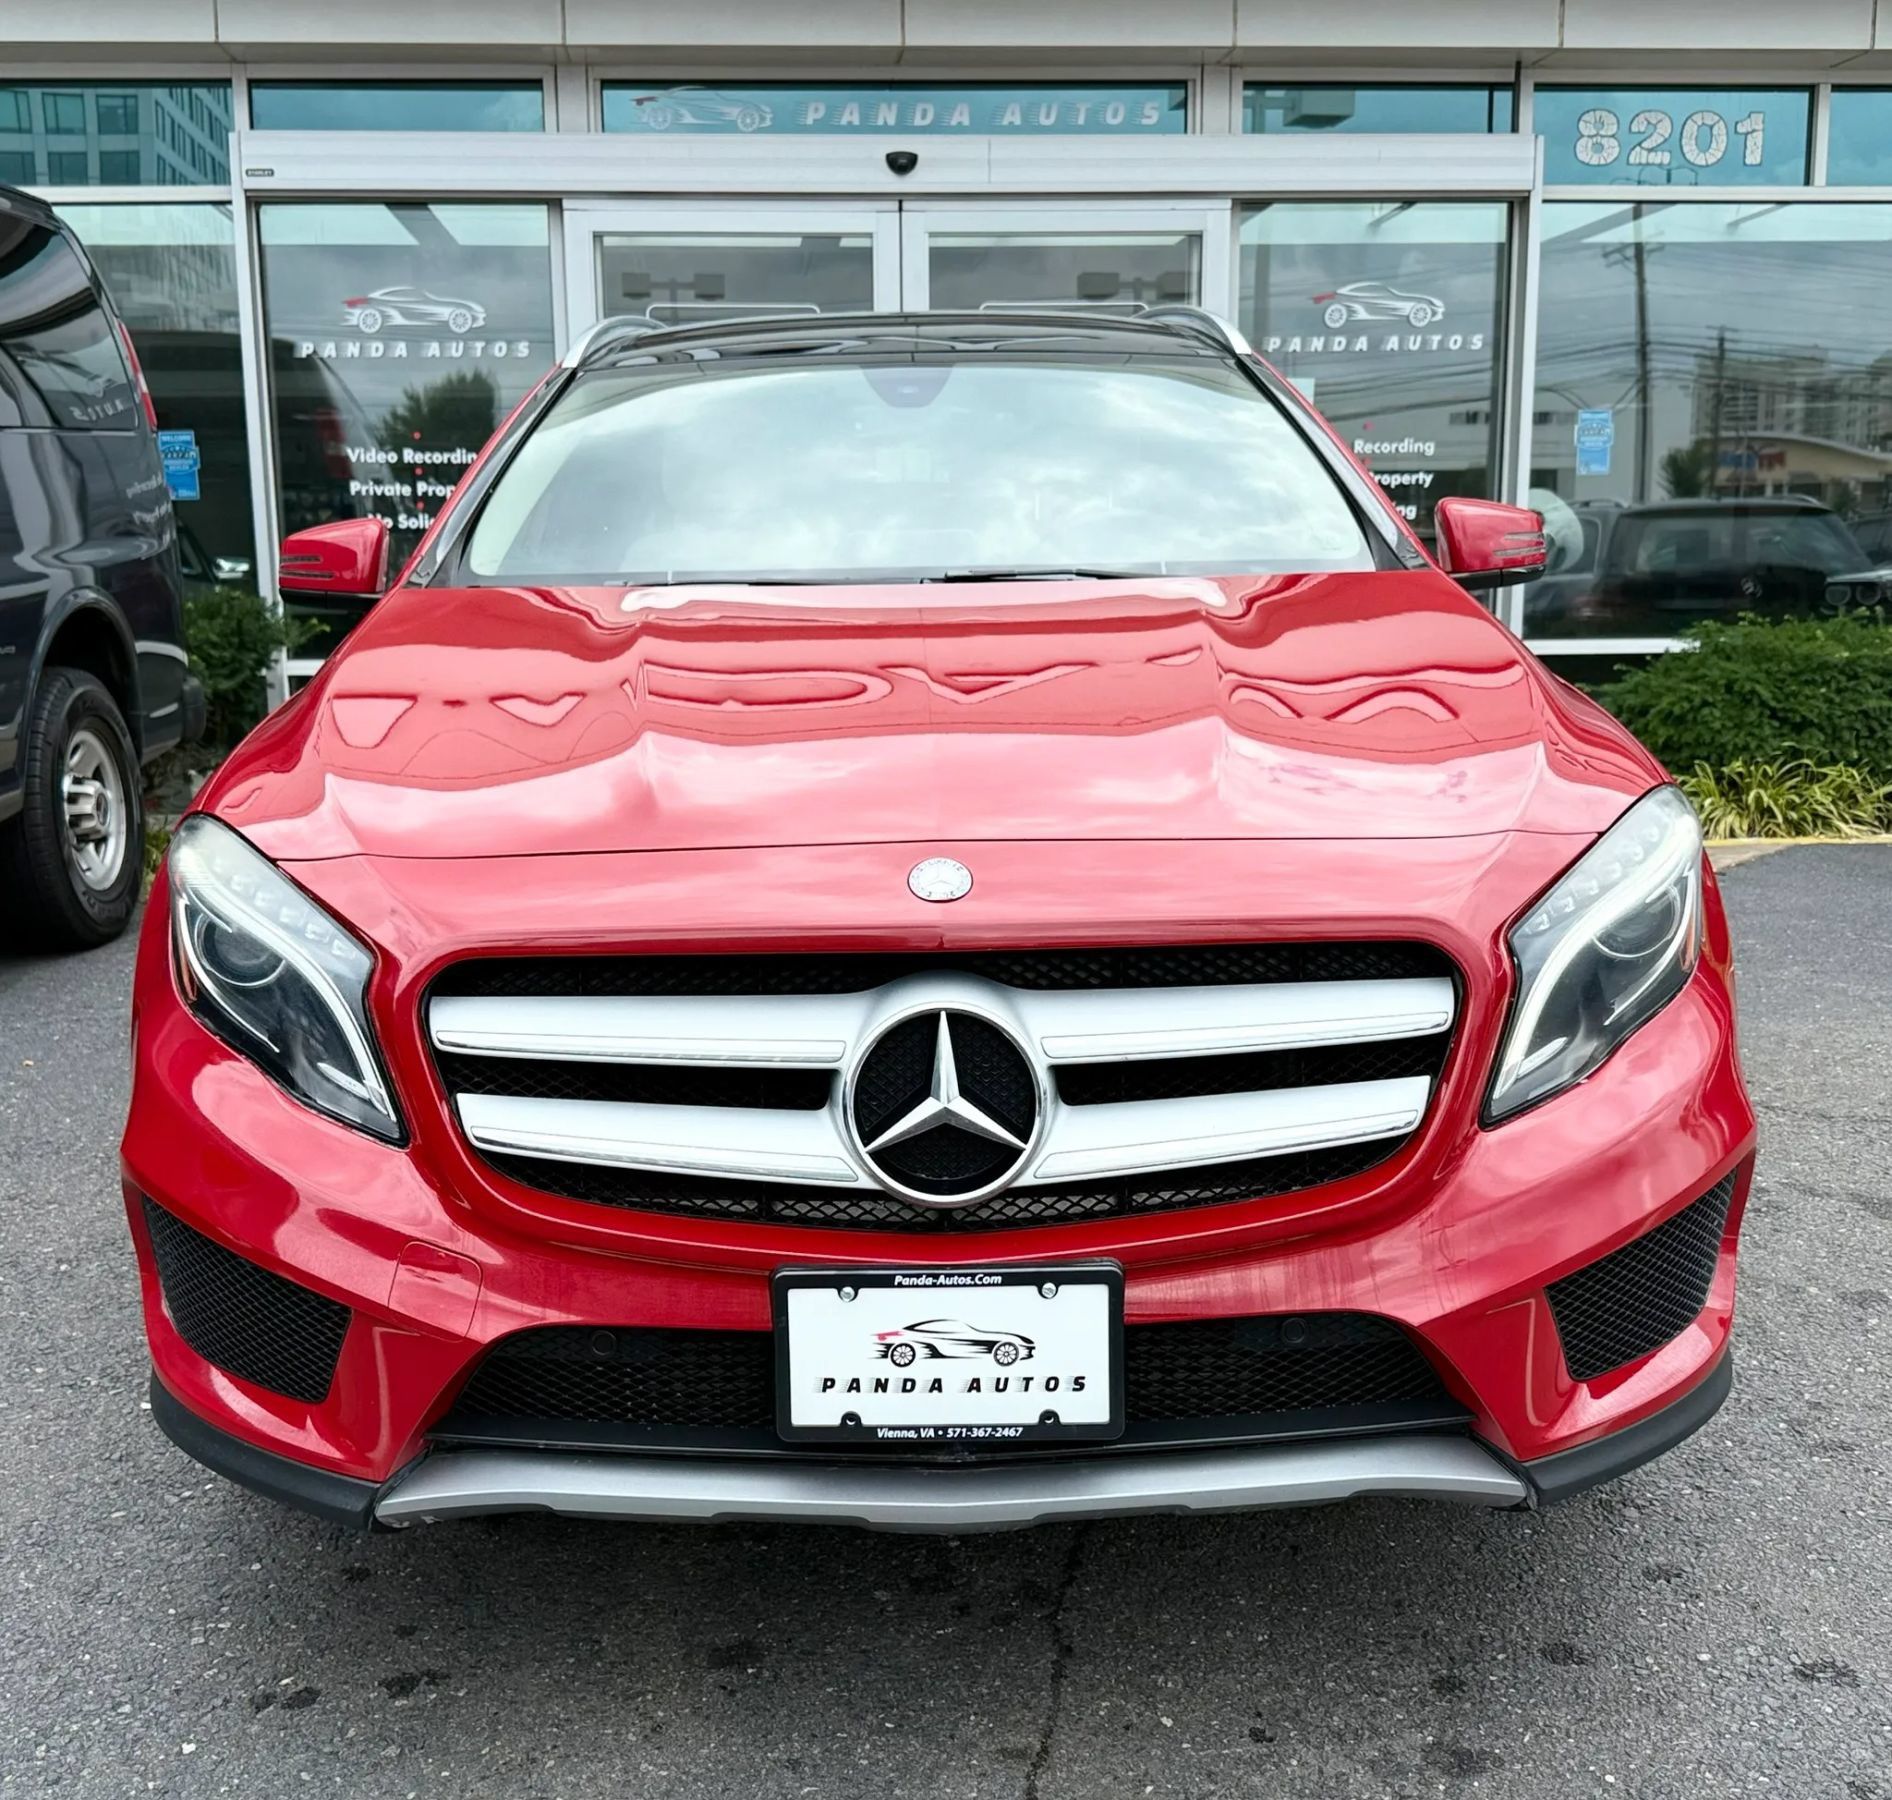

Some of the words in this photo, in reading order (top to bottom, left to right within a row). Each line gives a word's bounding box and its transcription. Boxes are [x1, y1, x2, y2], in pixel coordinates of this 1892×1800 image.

[805, 102, 970, 126] PANDA
[1002, 102, 1160, 126] AUTOS
[1574, 108, 1766, 167] 8201
[301, 341, 407, 358] PANDA
[428, 341, 530, 358] AUTOS
[1268, 335, 1368, 352] PANDA
[1387, 334, 1484, 351] AUTOS
[345, 447, 398, 463] Video
[402, 447, 477, 463] Recordin
[1353, 437, 1435, 456] Recording
[349, 479, 412, 496] Private
[1368, 471, 1434, 489] roperty
[1392, 501, 1417, 520] ng
[894, 1273, 1002, 1286] Panda-Autos.Com
[821, 1377, 943, 1393] PANDA
[967, 1376, 1086, 1393] AUTOS
[877, 1428, 918, 1439] Vienna,
[920, 1427, 935, 1438] VA
[946, 1427, 1023, 1438] 571-367-2467
